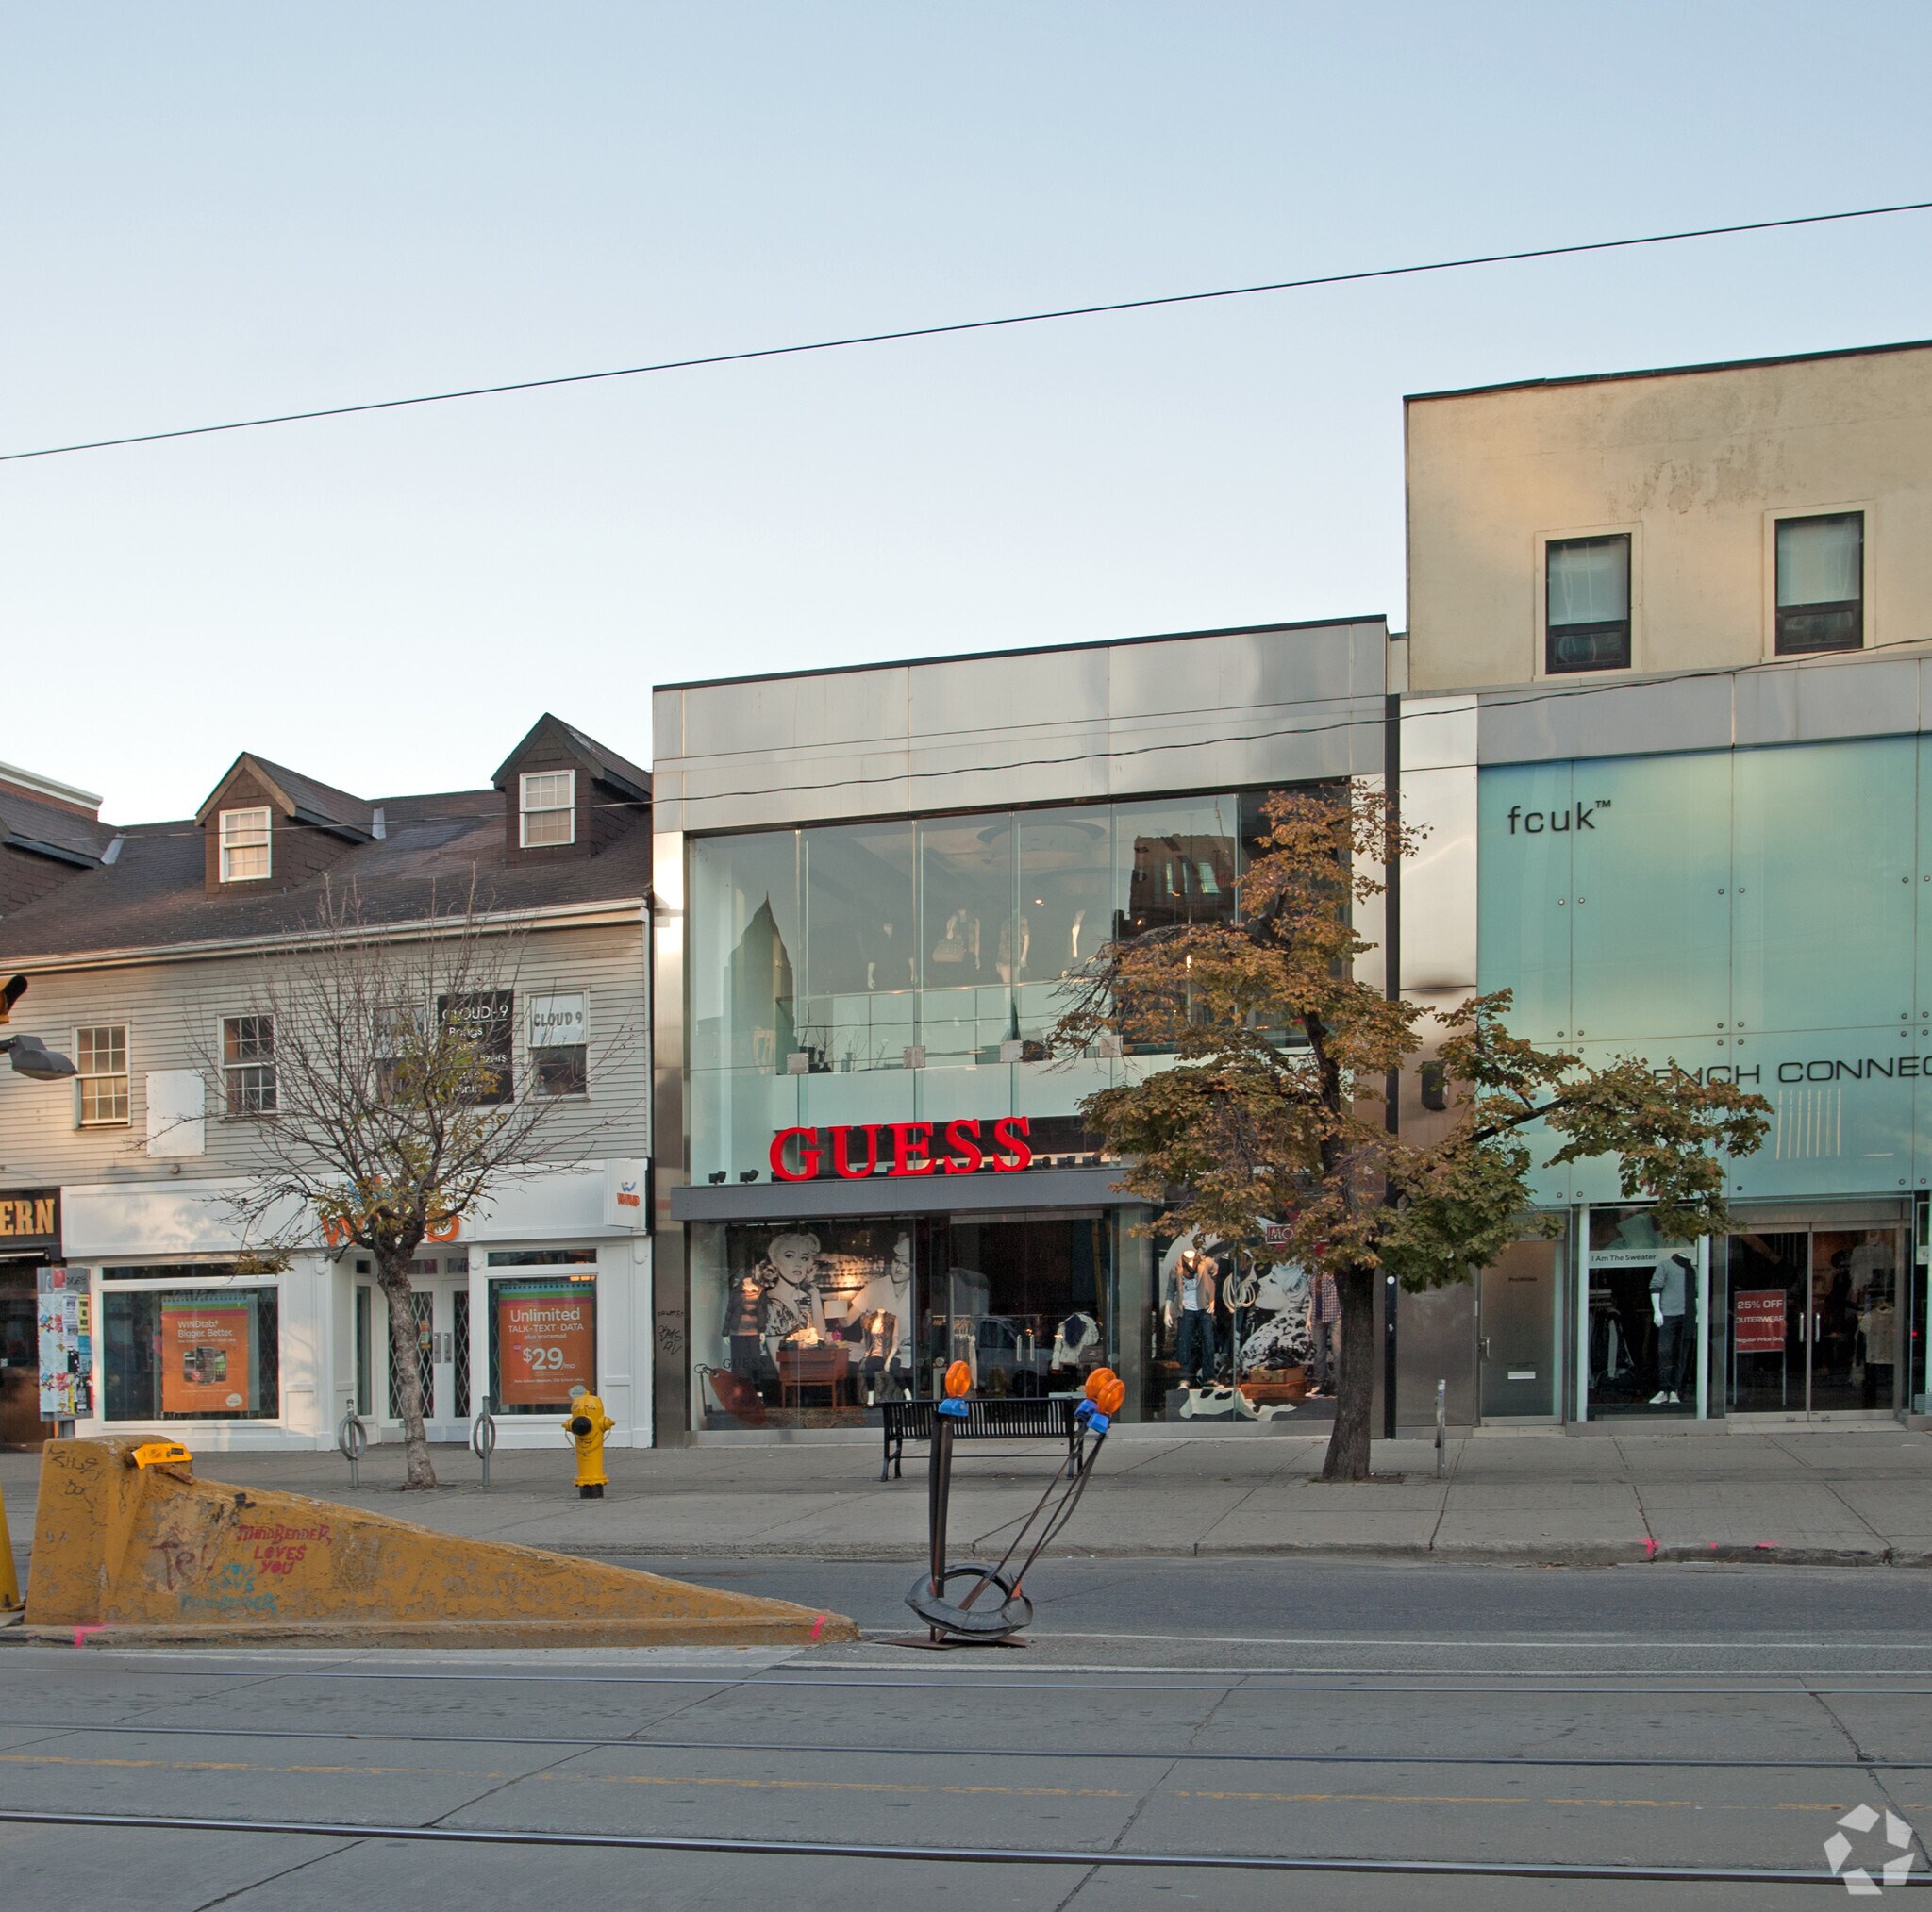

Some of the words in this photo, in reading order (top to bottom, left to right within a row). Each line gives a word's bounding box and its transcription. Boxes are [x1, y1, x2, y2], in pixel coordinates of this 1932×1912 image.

[534, 1012, 572, 1028] CLOUD
[575, 1010, 583, 1025] 9
[769, 1116, 1032, 1181] GUESS
[615, 1192, 641, 1206] WIND
[1625, 1253, 1657, 1261] Sweater
[1737, 1300, 1761, 1309] 25%
[1763, 1299, 1783, 1308] OFF
[510, 1307, 581, 1322] Unlimited
[254, 1543, 308, 1561] LOVES
[258, 1559, 295, 1575] YOU
